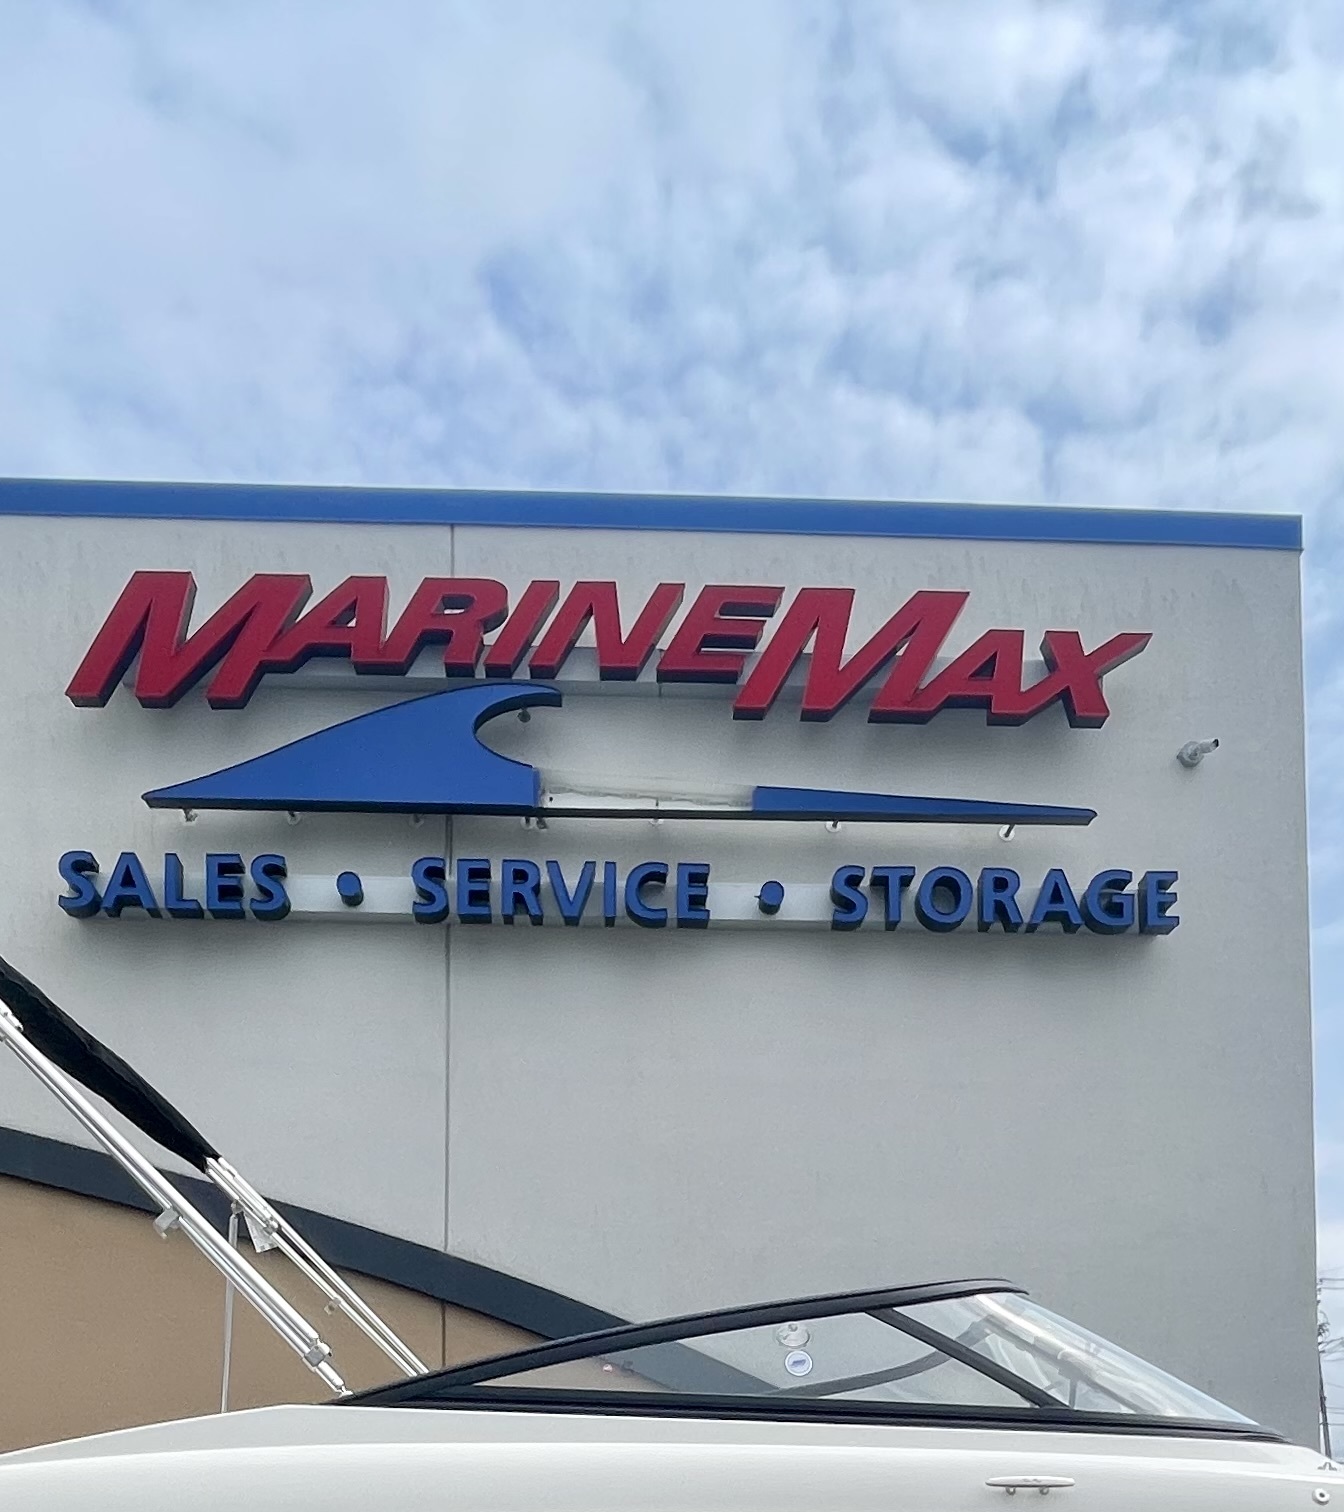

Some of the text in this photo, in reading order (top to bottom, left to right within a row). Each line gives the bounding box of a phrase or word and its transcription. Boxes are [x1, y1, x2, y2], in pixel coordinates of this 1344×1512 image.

[65, 571, 1153, 728] MARINEMAX
[58, 850, 1180, 934] SALES SERVICE STORAGE
